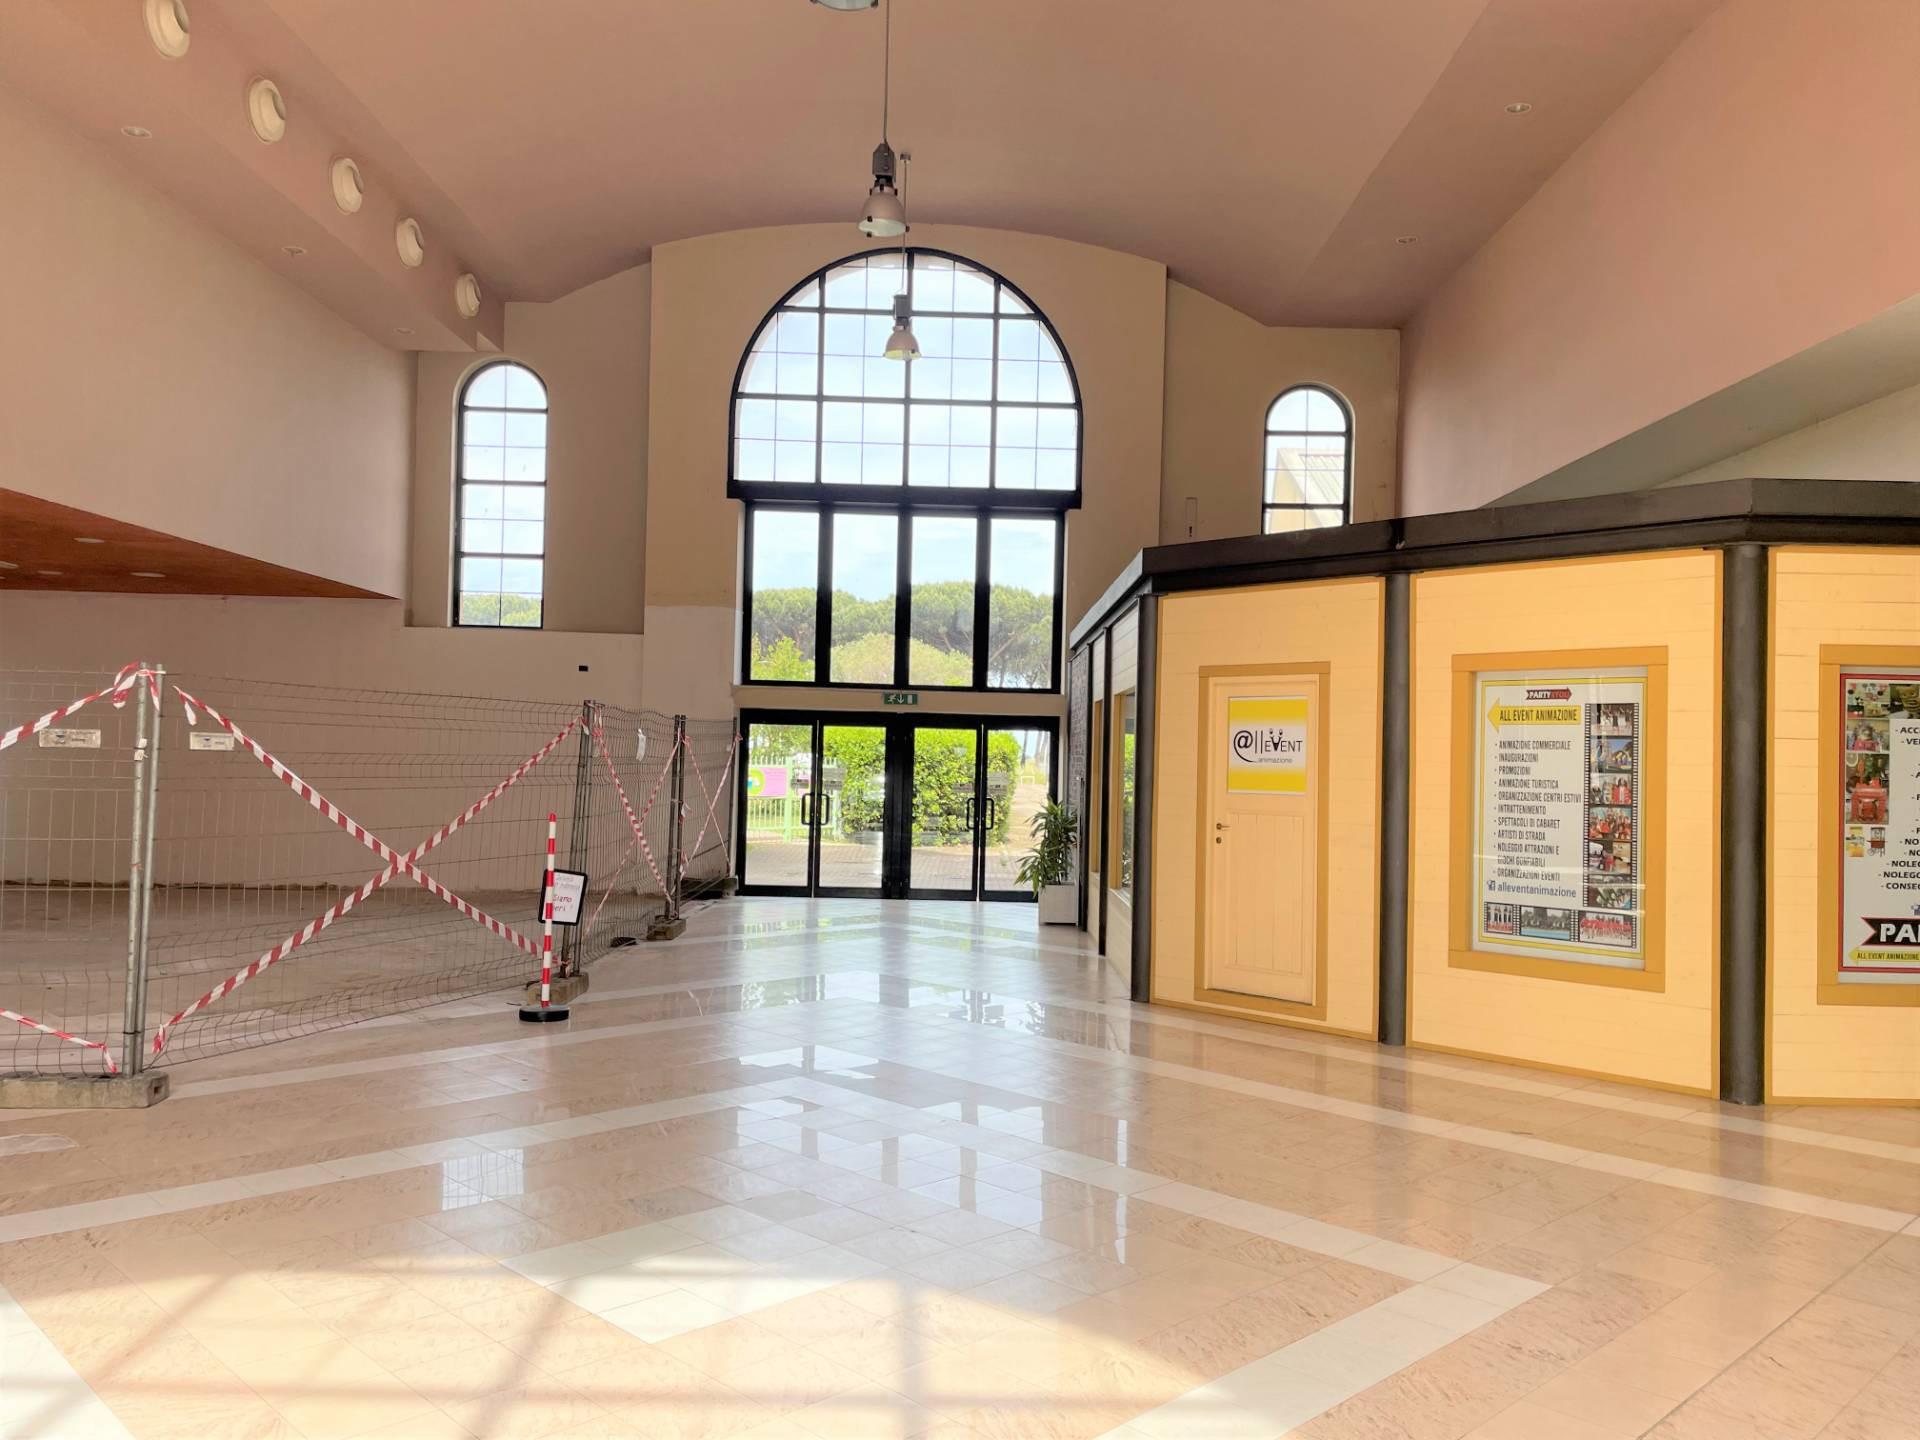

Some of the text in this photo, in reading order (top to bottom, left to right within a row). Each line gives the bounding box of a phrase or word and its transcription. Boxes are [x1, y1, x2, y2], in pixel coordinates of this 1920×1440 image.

[1499, 709, 1511, 721] ALL
[1513, 709, 1533, 721] EVENT
[1900, 726, 1920, 734] ACC
[1499, 740, 1571, 750] ANIMAZIONE COMMERCIALE
[1499, 753, 1539, 763] INAUGURAZIONI
[1498, 765, 1531, 775] PROMOZIONI
[1498, 778, 1559, 789] ANIMAZIONE TURISTICA
[1498, 791, 1582, 803] ORGANIZZAZIONE CENTRI ESTIVI
[1498, 804, 1546, 815] INTRATTENIMENTO
[1497, 817, 1560, 829] SPETTACOLI DI CABARET
[1497, 829, 1546, 841] ARTISTI DI STRADA
[1497, 842, 1560, 855] NOLEGGIO ATTRAZIONI E
[1497, 855, 1546, 867] GIOCHI GONFIABILI
[1497, 868, 1561, 881] ORGANIZZAZIONI EVENTI
[1497, 881, 1576, 898] alleventanimazione
[1879, 923, 1920, 943] PA
[1856, 951, 1920, 961] ALL EVENT ANIMAZIONE
